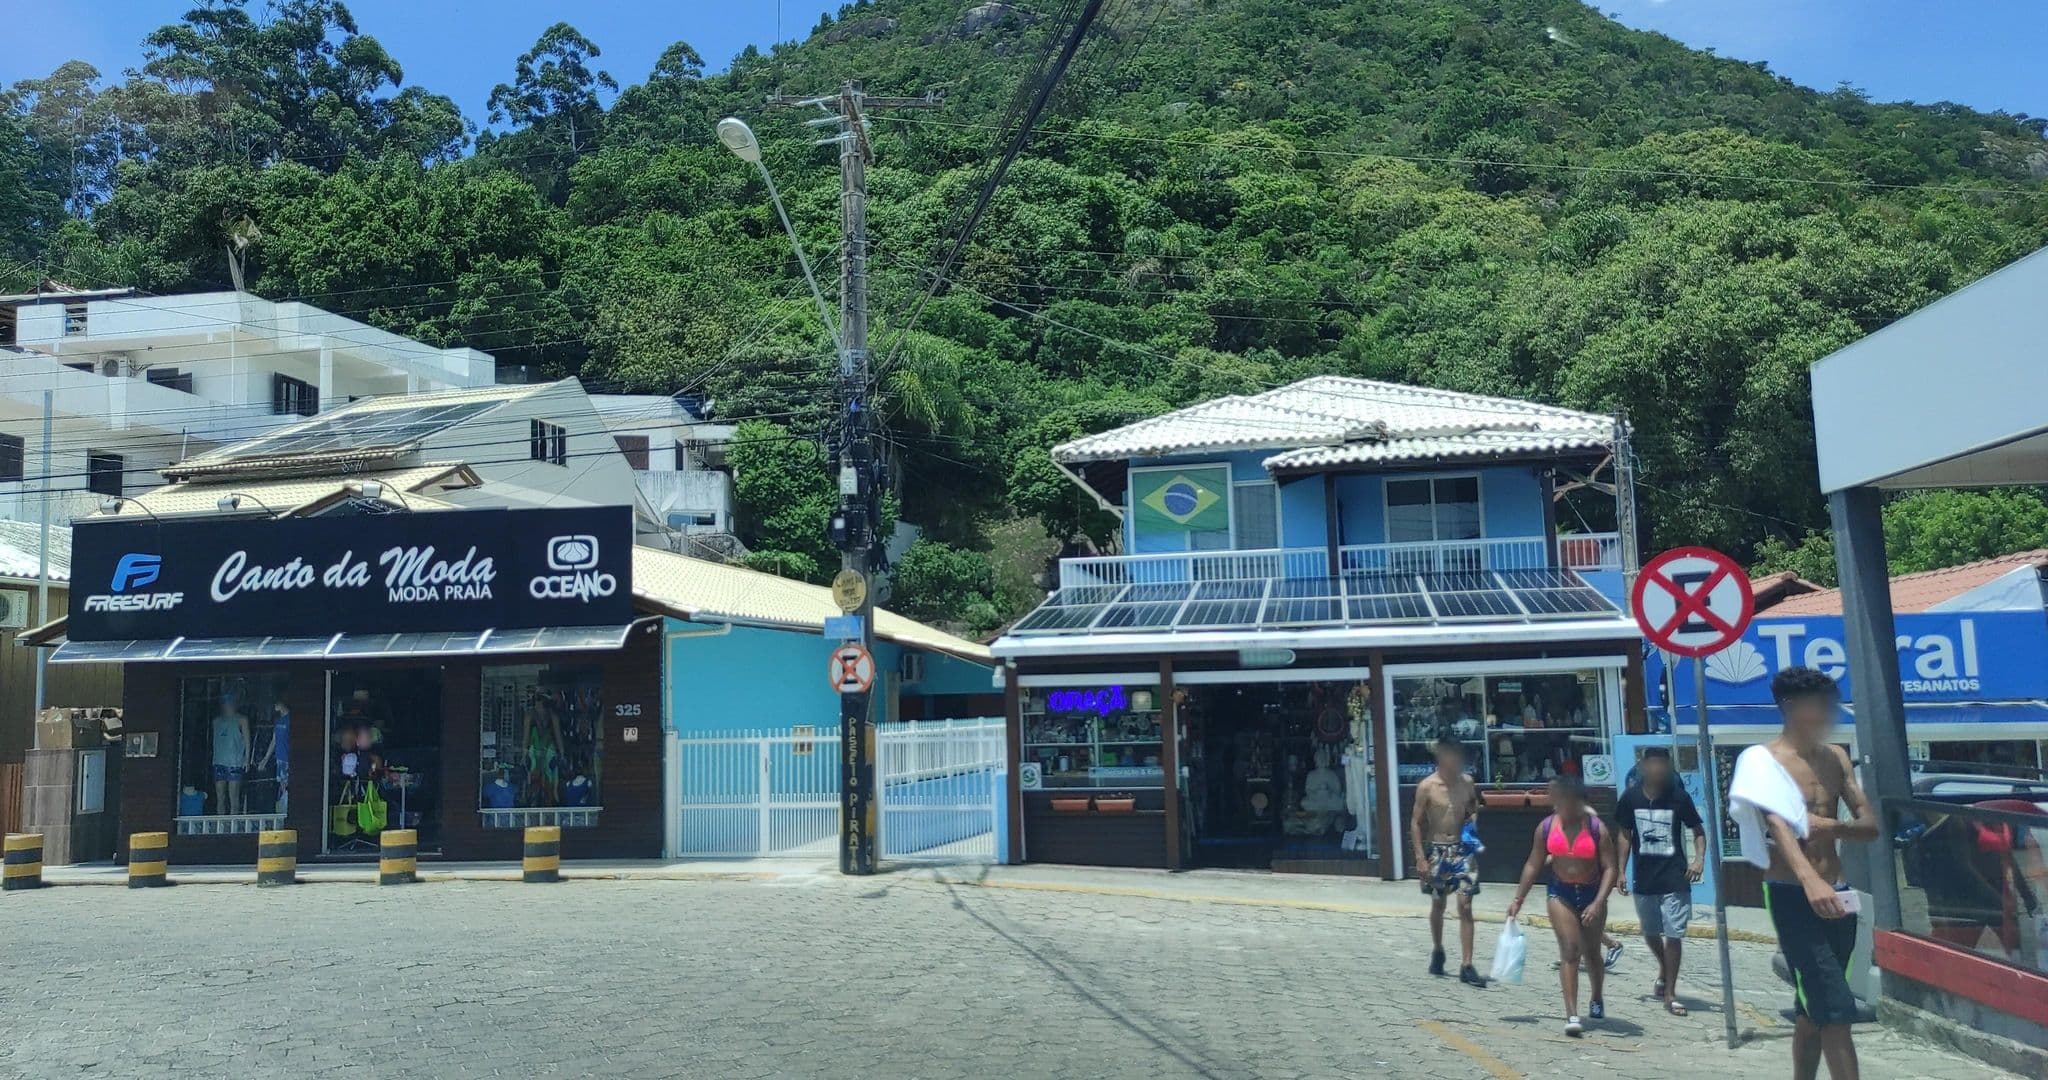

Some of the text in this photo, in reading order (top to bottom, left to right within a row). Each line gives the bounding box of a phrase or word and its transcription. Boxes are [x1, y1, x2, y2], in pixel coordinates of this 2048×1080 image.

[211, 545, 497, 602] Canto da Moda
[529, 570, 617, 603] OCEANO
[84, 592, 185, 612] FREESURF
[388, 581, 493, 603] MODA PRAIA
[1757, 619, 1980, 681] Teal
[615, 703, 642, 716] 325
[848, 717, 859, 872] PASSEIO PIRATA
